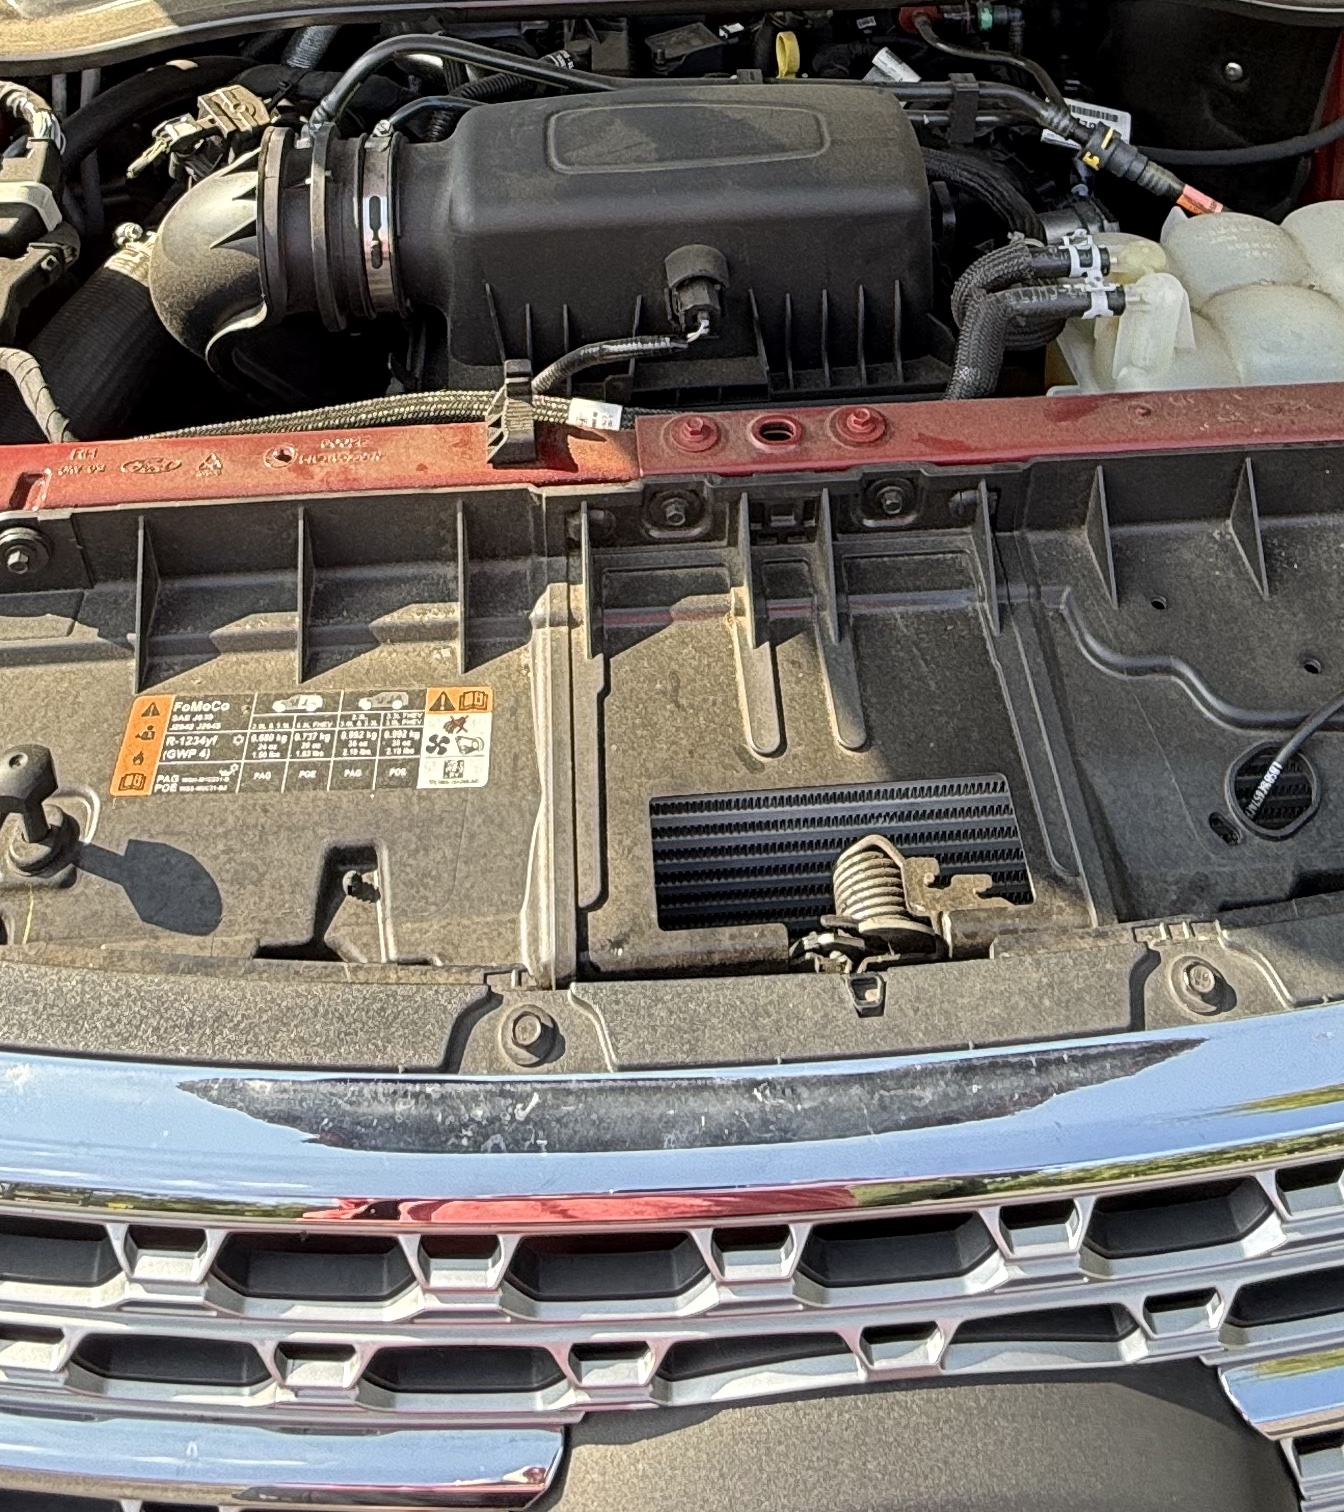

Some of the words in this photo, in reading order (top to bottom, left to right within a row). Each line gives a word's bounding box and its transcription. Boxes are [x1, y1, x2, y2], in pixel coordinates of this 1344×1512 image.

[173, 701, 230, 712] FoMoCo
[276, 733, 288, 744] kg
[320, 732, 331, 743] kg
[367, 731, 377, 740] kg
[409, 730, 420, 739] kg
[166, 735, 218, 747] R-1234yf
[163, 749, 196, 760] (GWP
[199, 749, 210, 759] 4)
[253, 771, 271, 780] PAG
[299, 770, 317, 778] POE
[344, 769, 362, 777] PAG
[389, 768, 407, 777] POE
[156, 775, 179, 783] PAG
[154, 784, 177, 792] POE
